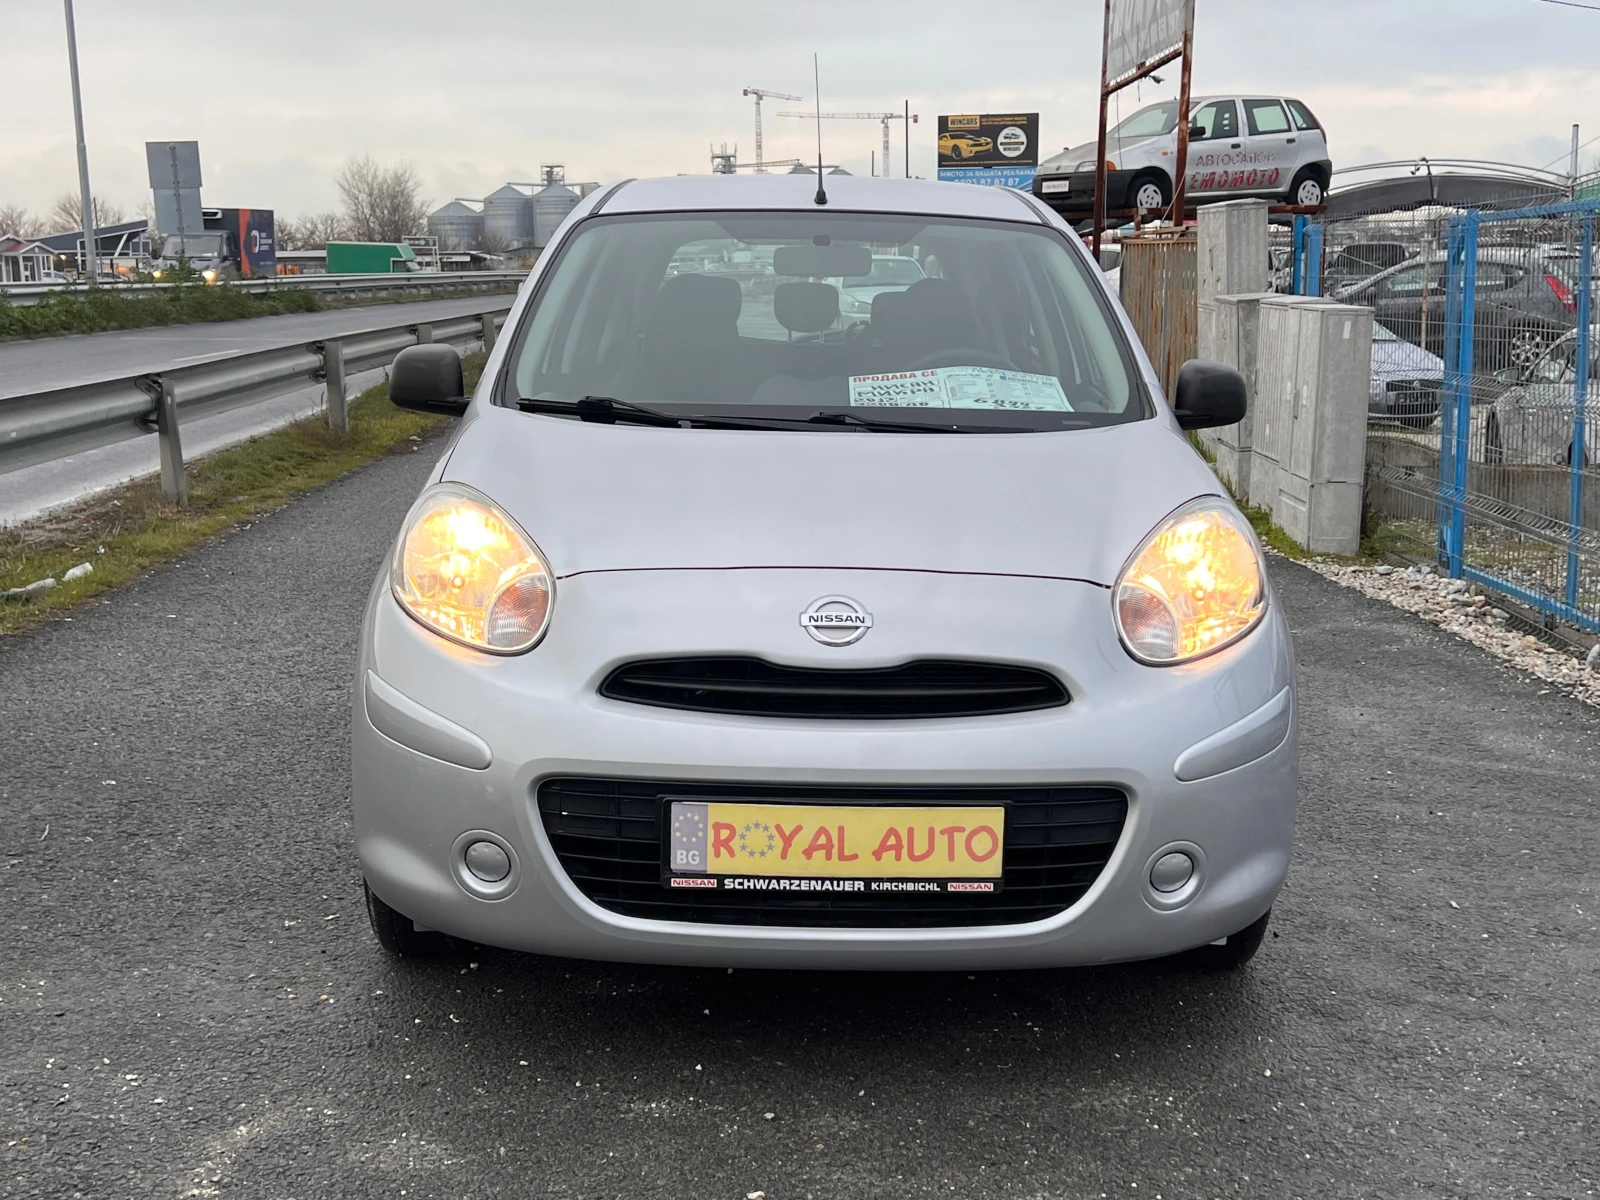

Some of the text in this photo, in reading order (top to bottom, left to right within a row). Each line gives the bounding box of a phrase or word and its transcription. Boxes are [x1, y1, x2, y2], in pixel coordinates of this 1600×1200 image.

[950, 118, 978, 126] WINCARS
[1008, 178, 1020, 186] 87
[853, 372, 917, 383] ПРОДАВА
[808, 614, 865, 624] NISSAN
[871, 824, 1000, 862] AUTO
[676, 849, 700, 865] BG
[672, 878, 993, 892] NISSAN SCHWARZENAUER KIRCHBICHL NISSAN
